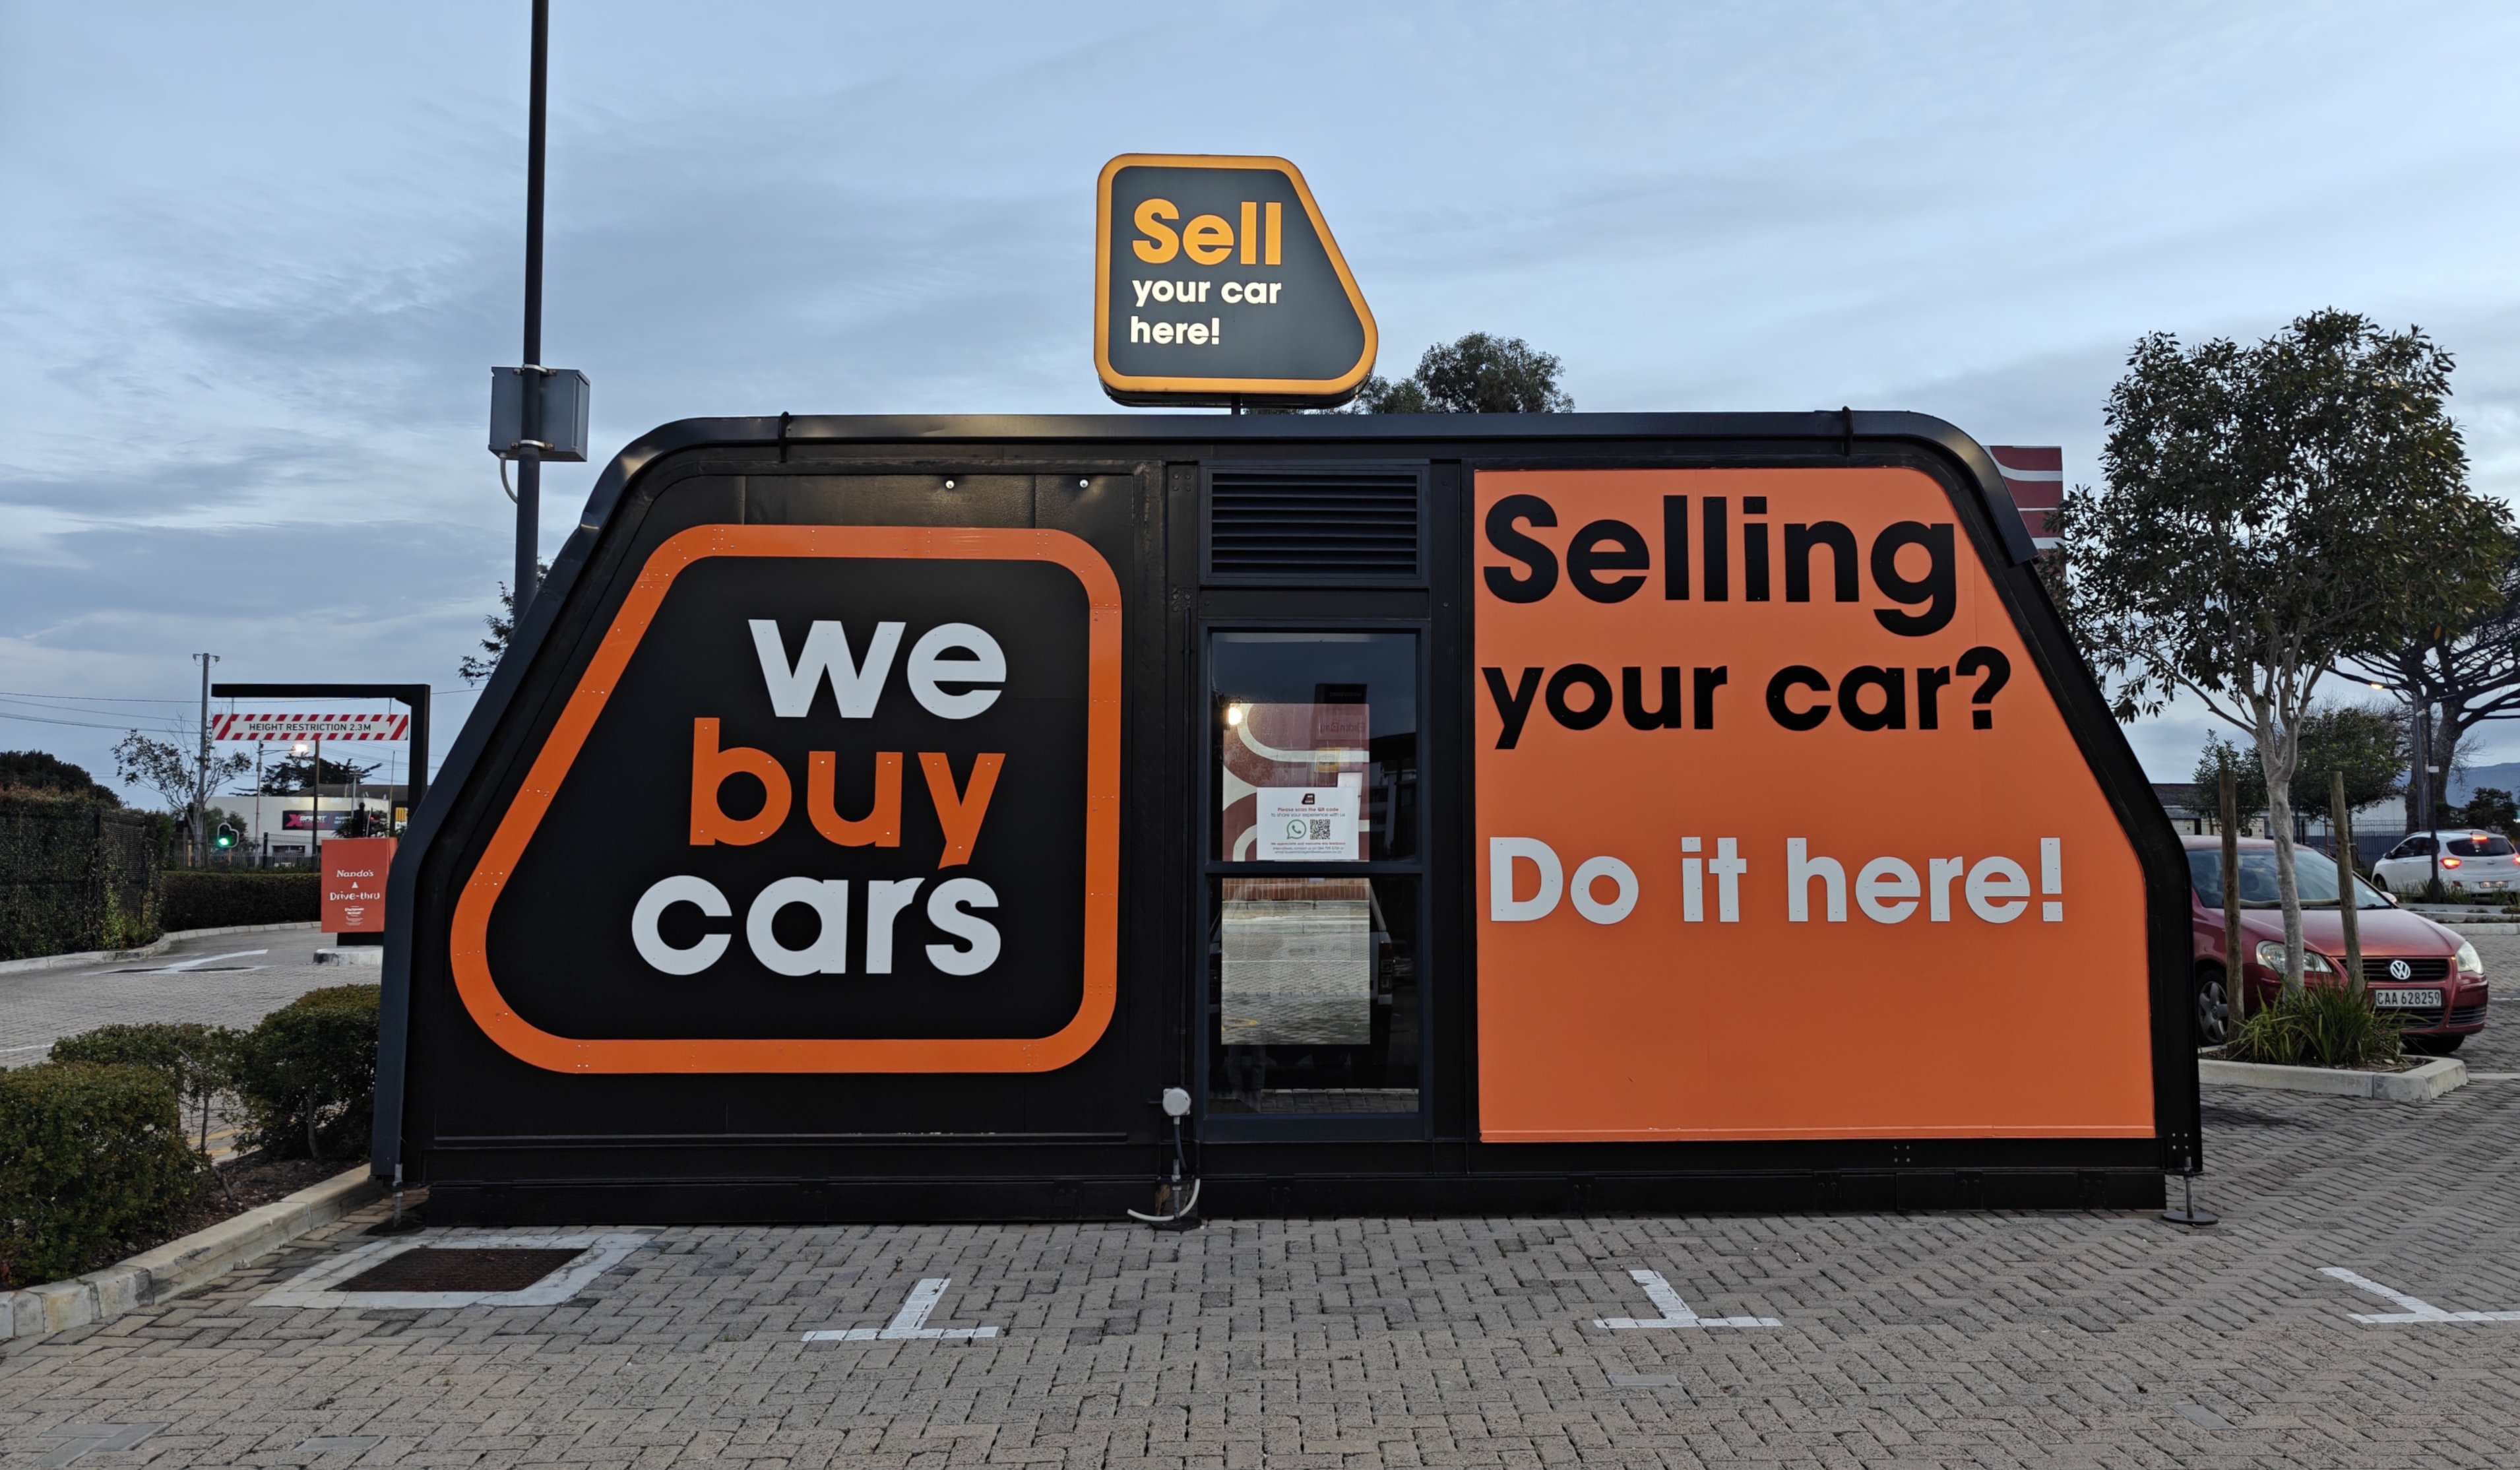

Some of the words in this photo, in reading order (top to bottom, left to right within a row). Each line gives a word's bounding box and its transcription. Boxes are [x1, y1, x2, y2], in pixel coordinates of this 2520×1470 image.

[1132, 198, 1282, 265] Sell
[1130, 315, 1220, 344] here!
[1132, 280, 1211, 307] your
[1221, 281, 1282, 304] car
[1483, 494, 1957, 637] Selling
[748, 619, 1007, 719] we
[1481, 662, 1728, 750] your
[1766, 646, 2011, 732] car?
[689, 717, 1006, 870] buy
[330, 891, 381, 901] Drive-thru
[1490, 837, 1639, 925] Do
[1682, 837, 1748, 923] it
[1787, 837, 2063, 924] here!
[631, 875, 1001, 976] cars
[2377, 992, 2399, 1005] CAA
[2401, 991, 2440, 1004] 628259
